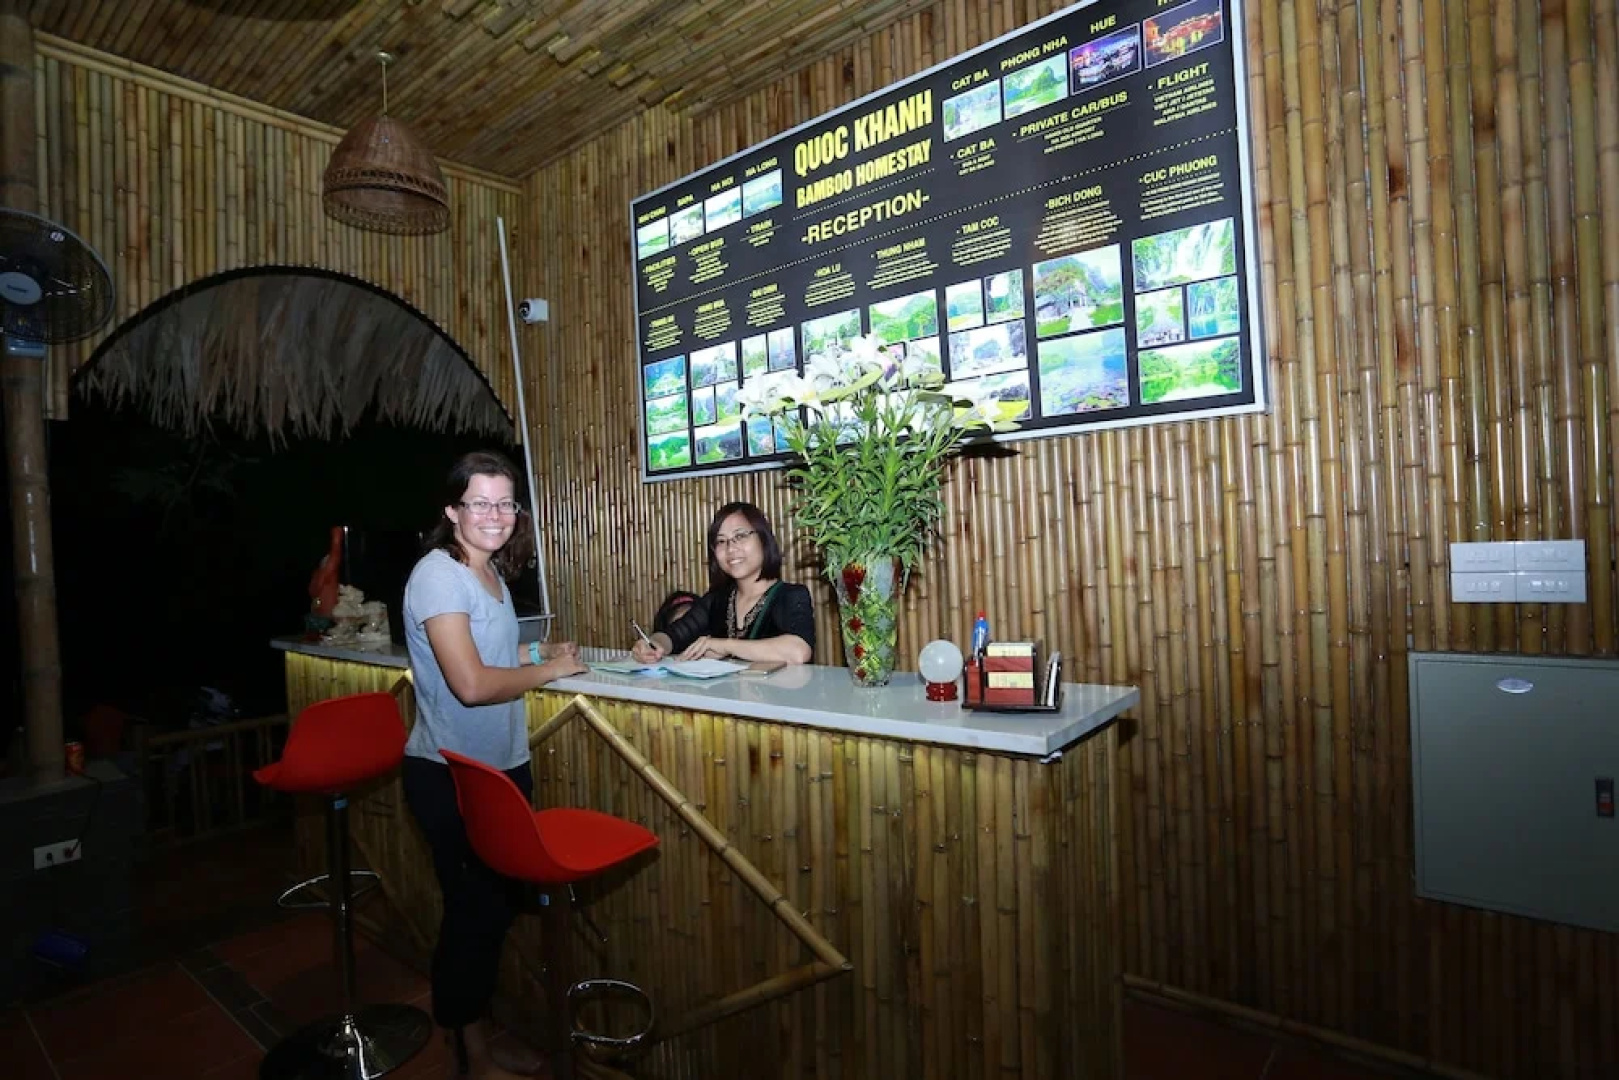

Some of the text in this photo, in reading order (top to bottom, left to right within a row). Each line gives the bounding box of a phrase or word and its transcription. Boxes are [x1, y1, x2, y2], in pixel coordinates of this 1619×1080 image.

[1090, 14, 1117, 34] HUE
[1001, 35, 1068, 71] PHONG NHA
[951, 68, 989, 91] CAT BA
[1157, 62, 1209, 89] FLIGHT
[1020, 111, 1069, 137] PRIVATE
[1071, 91, 1128, 119] CAR/BUS
[794, 88, 932, 177] QUOC KHANH
[957, 138, 996, 158] CAT BA
[796, 169, 853, 209] BAMBOO
[856, 138, 932, 187] HOMESTAY
[1143, 154, 1218, 185] CUC PHUONG
[1048, 185, 1102, 209] BICH DONG
[961, 221, 980, 236] TAM
